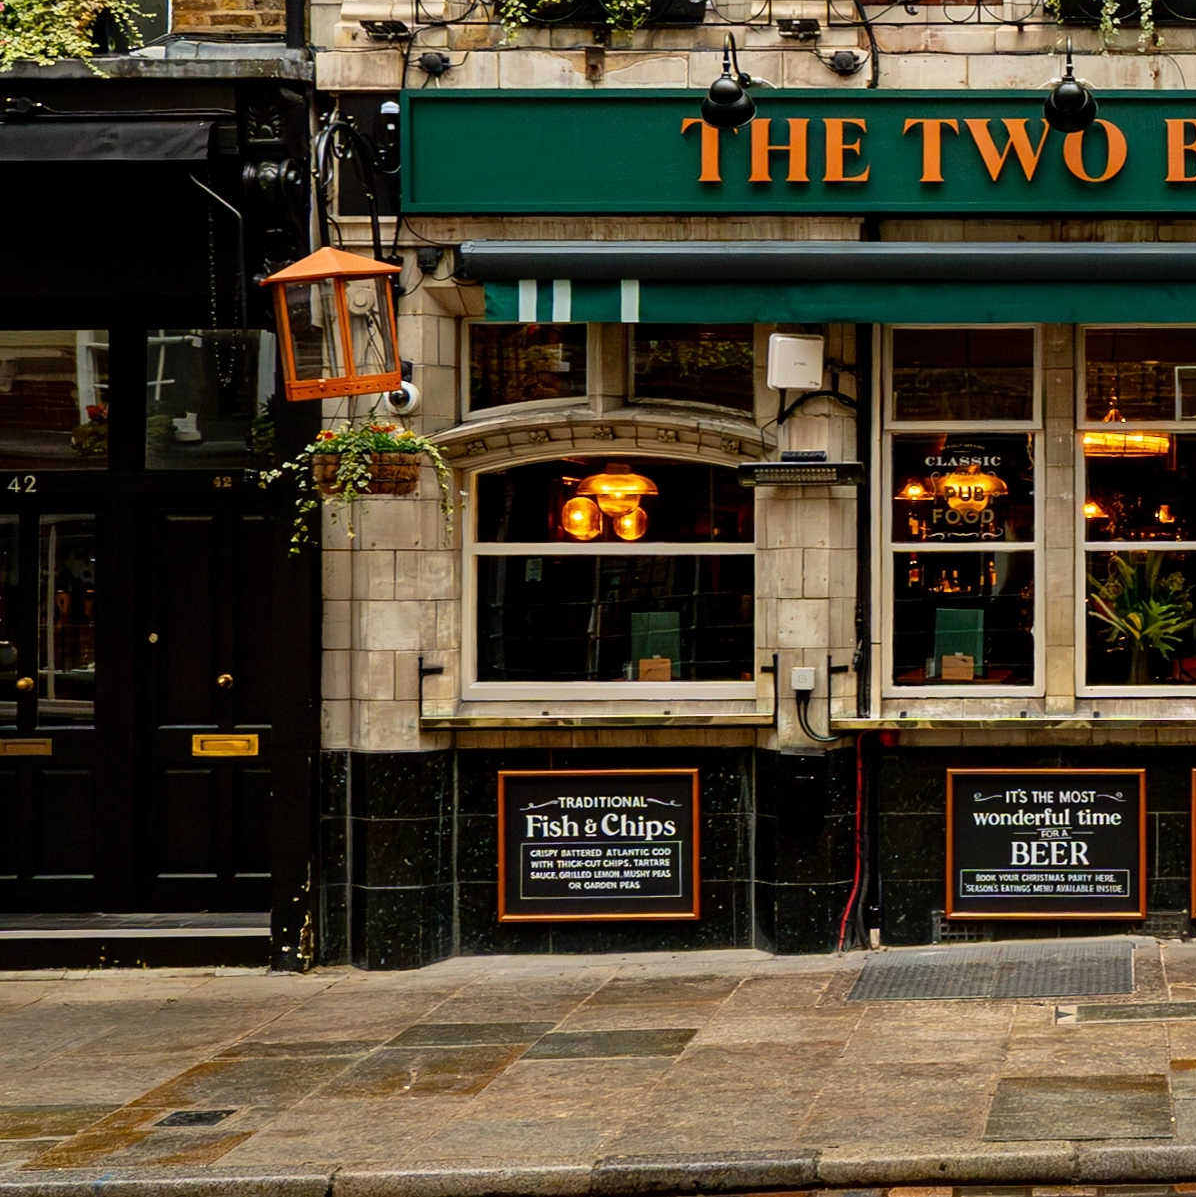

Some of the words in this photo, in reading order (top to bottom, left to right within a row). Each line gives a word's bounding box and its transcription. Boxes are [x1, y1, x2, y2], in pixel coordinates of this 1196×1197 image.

[681, 118, 870, 182] THE
[903, 118, 1127, 182] TWO
[924, 456, 1002, 467] CLASSIC
[7, 475, 37, 493] 42
[213, 476, 232, 487] 42
[944, 486, 985, 502] PUB
[932, 508, 995, 524] FOOD
[1005, 788, 1029, 804] IT'S
[1031, 790, 1055, 804] THE
[1059, 790, 1097, 803] MOST
[557, 796, 648, 809] TRADITIONAL
[972, 807, 1071, 826] wonderful
[1075, 808, 1123, 826] time
[525, 814, 580, 838] Fish
[583, 818, 598, 837] &
[600, 813, 677, 841] Chips
[1040, 829, 1060, 838] FOR
[1061, 829, 1069, 837] A
[530, 849, 559, 858] CRISPY
[560, 849, 603, 857] BATTERED
[605, 848, 650, 857] ATLANTIC
[651, 848, 672, 856] COD
[1010, 841, 1090, 865] BEER
[530, 860, 554, 869] WITH
[556, 859, 602, 868] THICK-CUT
[633, 858, 671, 867] TARTARE
[559, 871, 593, 879] GRILLED
[623, 870, 650, 878] MUSHY
[651, 870, 672, 878] PEAS
[975, 873, 997, 882] BOOK
[998, 874, 1020, 882] YOUR
[1021, 874, 1066, 882] CHRISTMAS
[1067, 873, 1093, 882] PARTY
[568, 881, 582, 890] OR
[583, 881, 618, 889] GARDEN
[619, 881, 641, 889] PEAS
[1033, 884, 1055, 893] MENU
[1056, 884, 1095, 893] AVAILABLE
